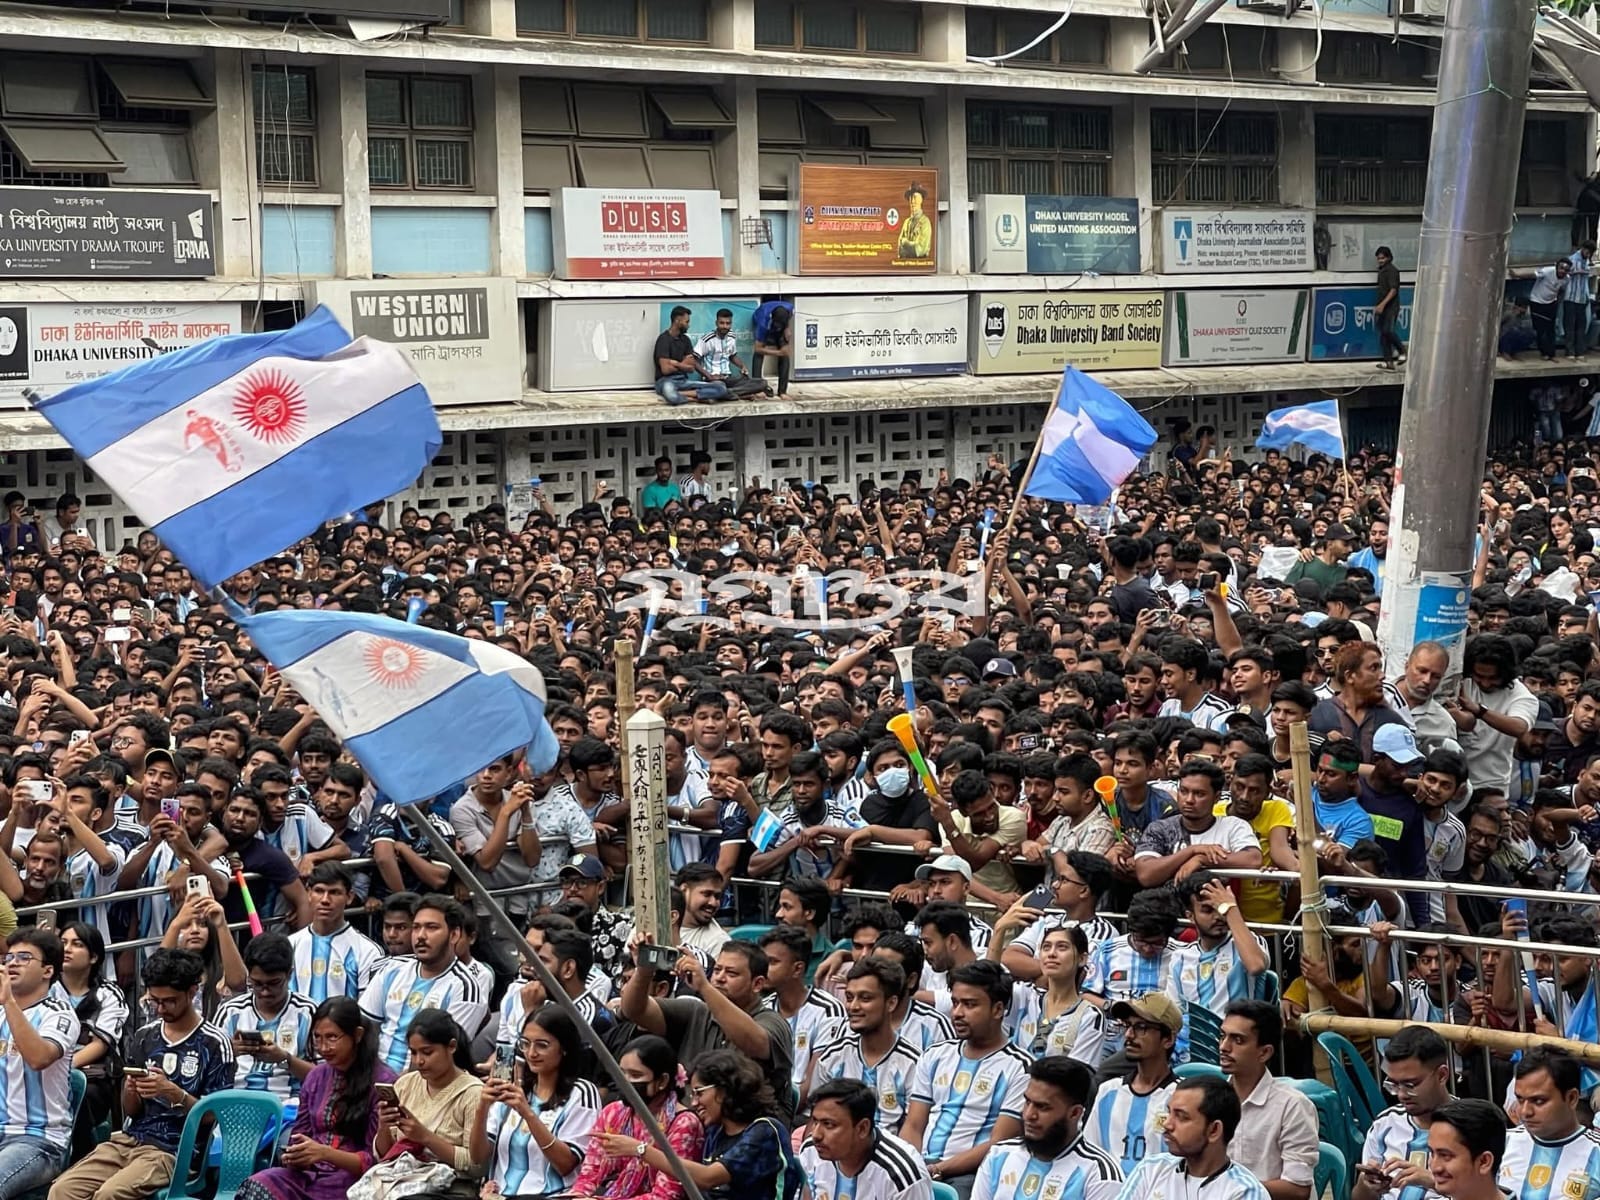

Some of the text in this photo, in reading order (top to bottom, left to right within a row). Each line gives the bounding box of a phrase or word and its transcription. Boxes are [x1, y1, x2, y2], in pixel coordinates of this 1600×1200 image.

[9, 208, 87, 233] বিশ্ববিদ্যালয়
[91, 211, 120, 234] নাট্য
[123, 217, 165, 232] সংসদ
[607, 209, 681, 227] DUSS
[1035, 211, 1129, 221] DHAKA UNIVERSITY MODEL
[1030, 223, 1137, 234] UNITED NATIONS ASSOCIATION
[0, 239, 165, 253] KA UNIVERSITY DRAMA TROUPE
[177, 240, 210, 259] DRAMA
[357, 294, 464, 317] WESTERN
[1018, 305, 1039, 320] ঢাকা
[1043, 300, 1096, 321] বিশ্ববিদ্যালয়
[1123, 299, 1162, 319] সোসাইটি
[40, 326, 68, 342] ঢাকা
[74, 320, 144, 341] ইউনিভার্সিটি
[148, 321, 178, 340] মাইম
[393, 315, 466, 337] UNION
[1017, 323, 1162, 345] Dhaka University Band Society
[1193, 326, 1287, 337] DHAKA UNIVERSITY QUIZ SOCIETY
[825, 327, 958, 348] ঢাকা ইউনিভার্সিটি ডিবেটিং সোসাইটি
[34, 348, 78, 362] DHAKA
[83, 346, 154, 361] UNIVERSITY
[411, 345, 482, 361] মানি ট্রান্সফার
[1120, 1135, 1147, 1161] 10
